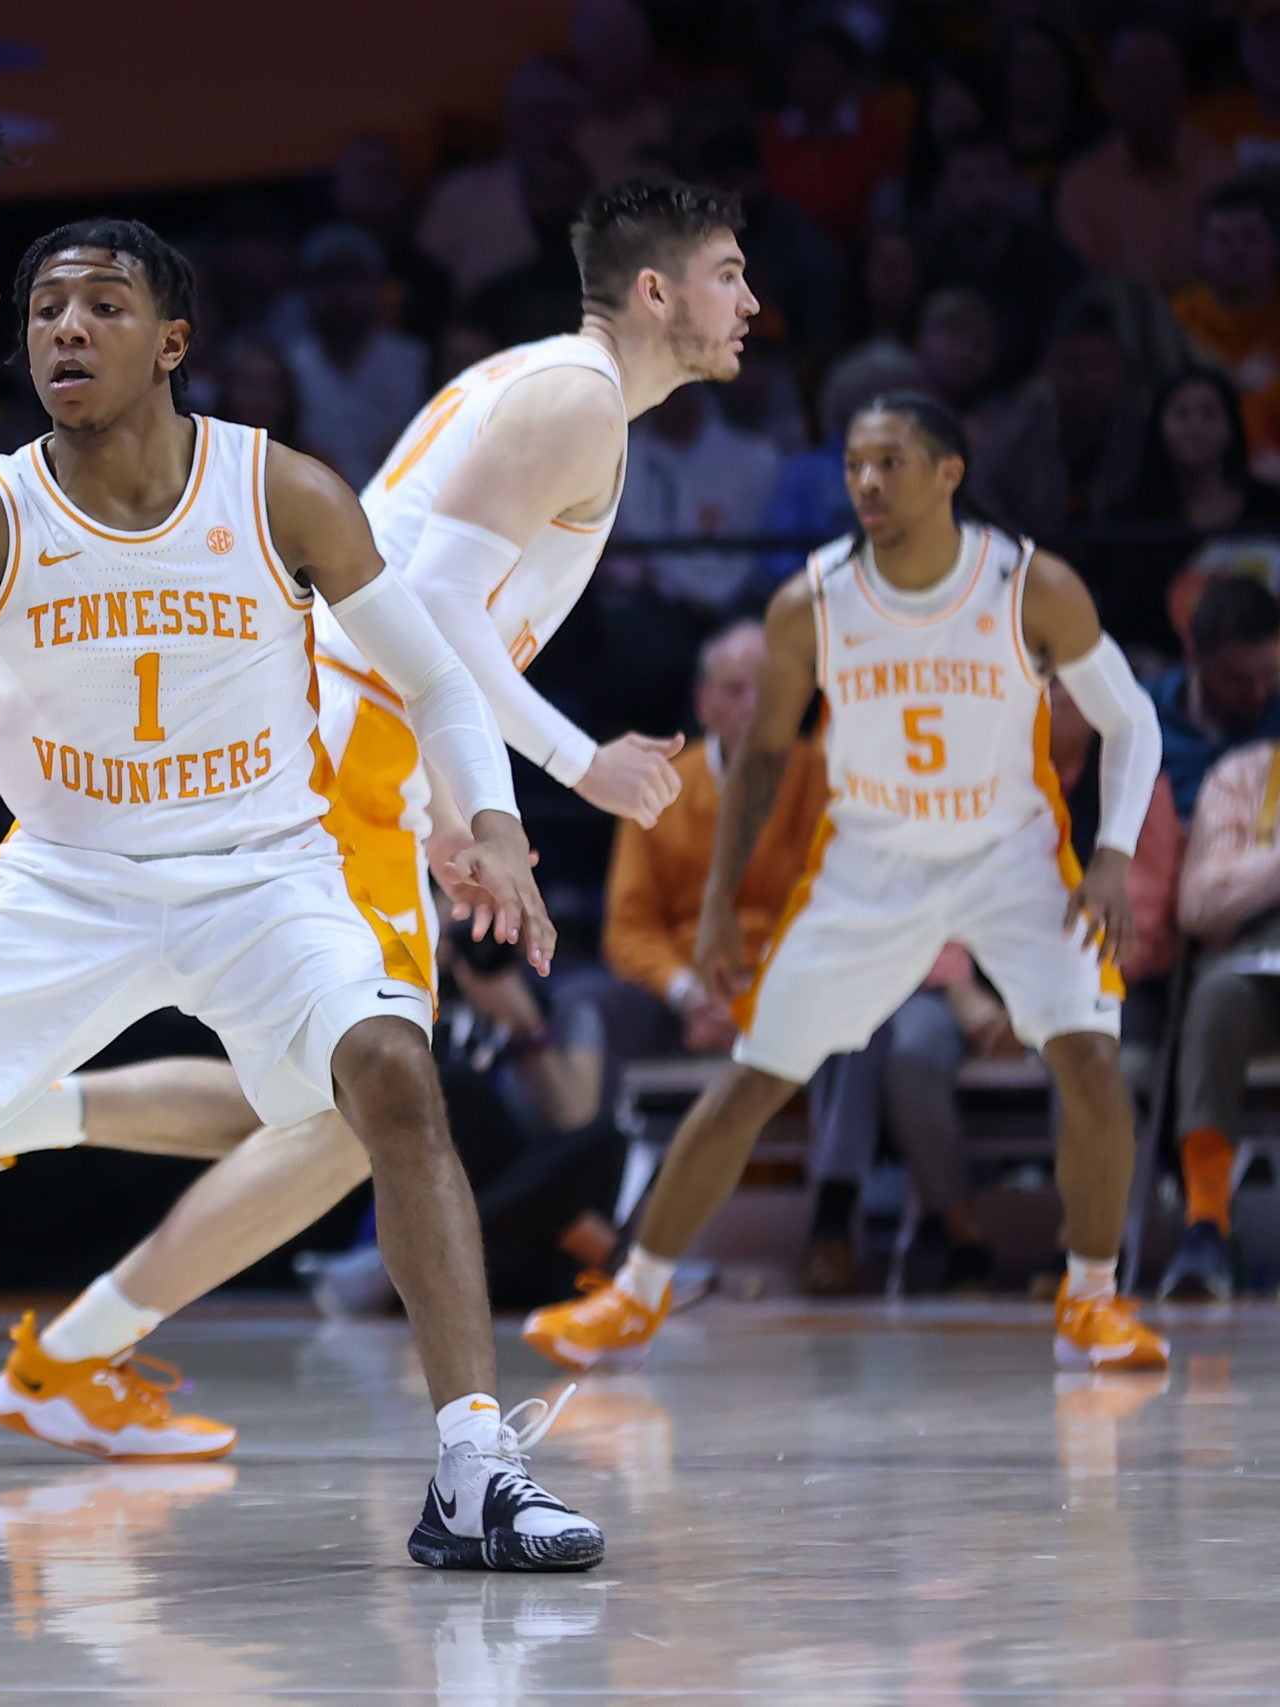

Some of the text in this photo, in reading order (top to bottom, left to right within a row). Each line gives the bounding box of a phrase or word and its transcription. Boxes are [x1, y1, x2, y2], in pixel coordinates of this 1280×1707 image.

[209, 529, 232, 552] SEC
[27, 590, 258, 648] TENNESSEE
[134, 652, 165, 741] 1
[837, 658, 1005, 702] TENNESSEE
[32, 727, 271, 804] VOLUNTEERS
[903, 706, 947, 775] 5
